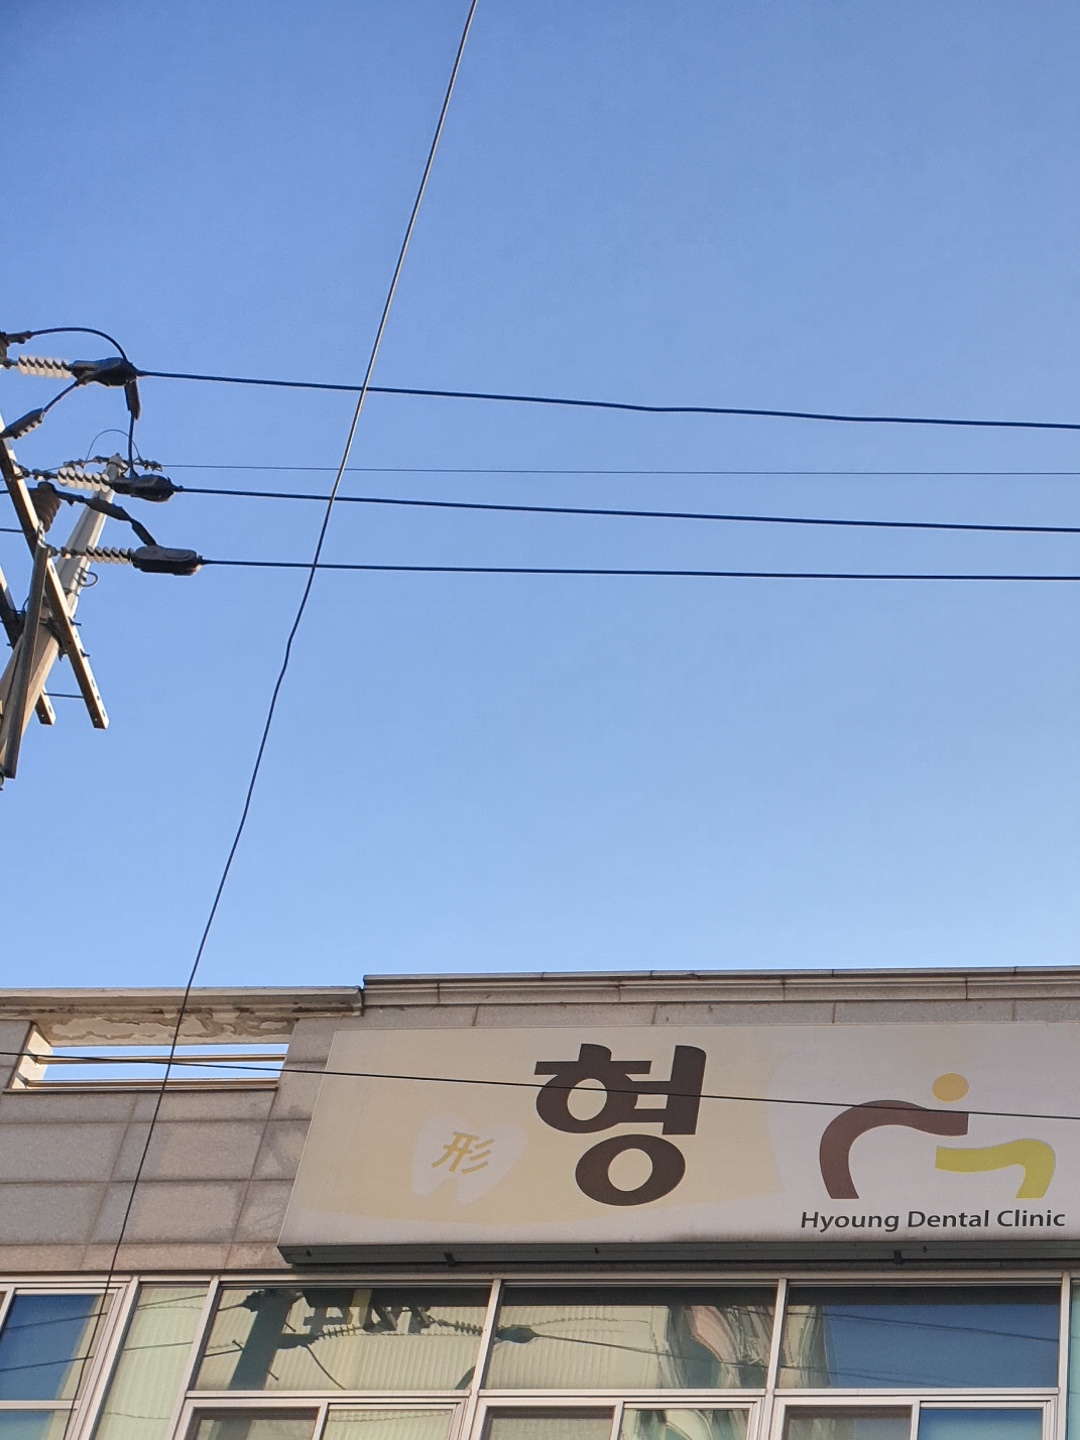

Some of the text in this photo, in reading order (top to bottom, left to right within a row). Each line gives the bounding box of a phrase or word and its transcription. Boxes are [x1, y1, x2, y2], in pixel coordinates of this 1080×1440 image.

[534, 1043, 708, 1207] 형
[432, 1131, 495, 1175] 形
[800, 1208, 1066, 1233] Hyoung Dental Clinic
